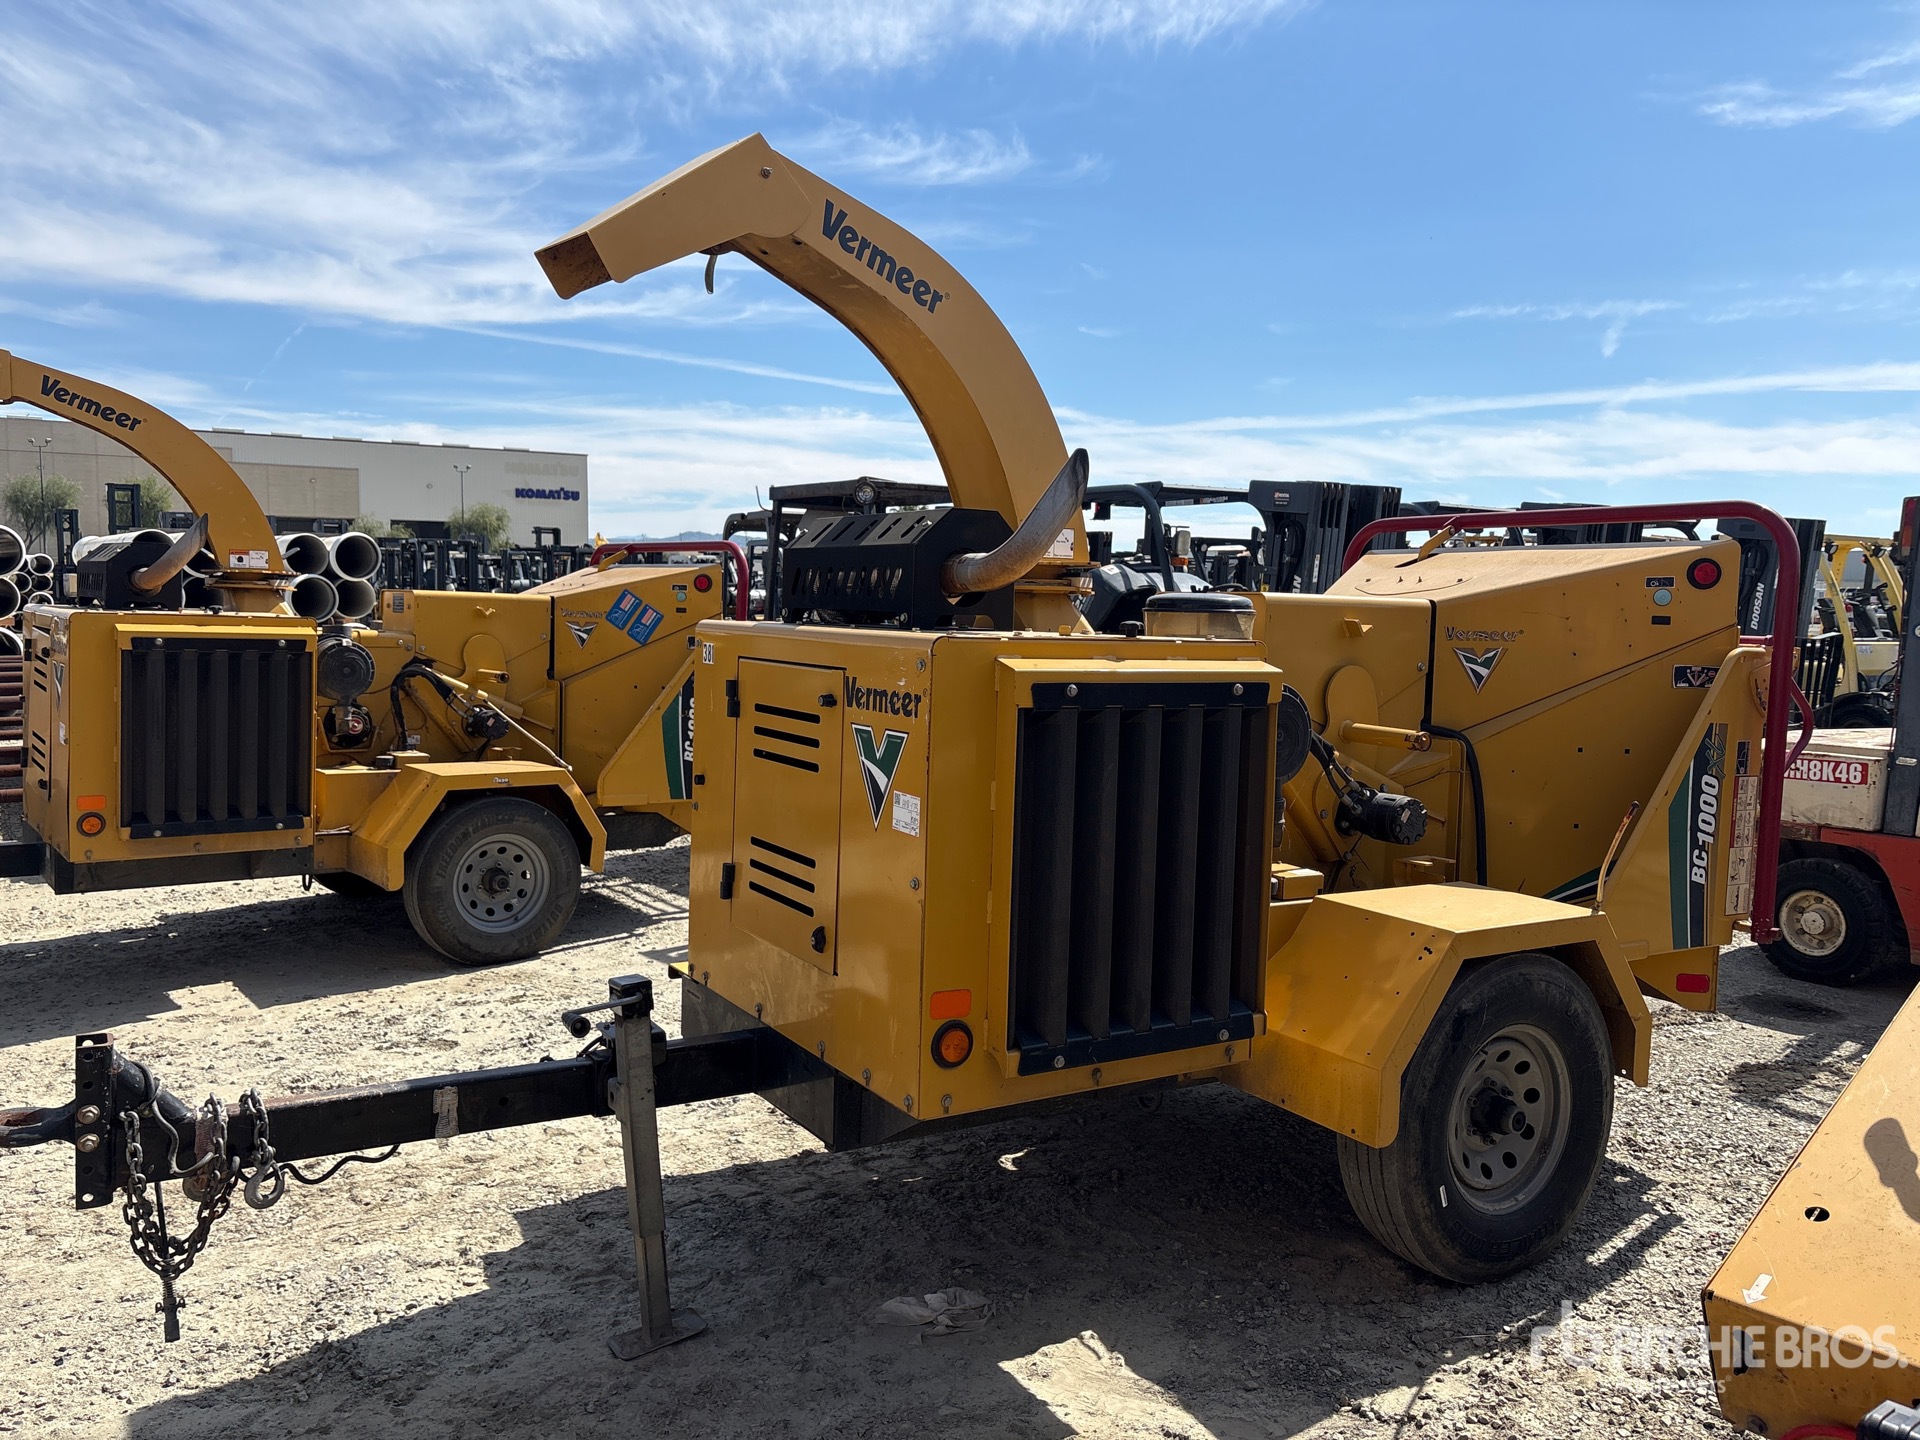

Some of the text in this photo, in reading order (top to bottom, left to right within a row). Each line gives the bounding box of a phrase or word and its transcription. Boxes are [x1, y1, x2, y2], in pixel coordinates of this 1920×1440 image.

[822, 198, 943, 314] Vermeer
[40, 374, 142, 432] Vermeer
[515, 487, 580, 501] KOMATSU
[1750, 582, 1765, 630] DOOSAN
[845, 675, 922, 719] Vermeer
